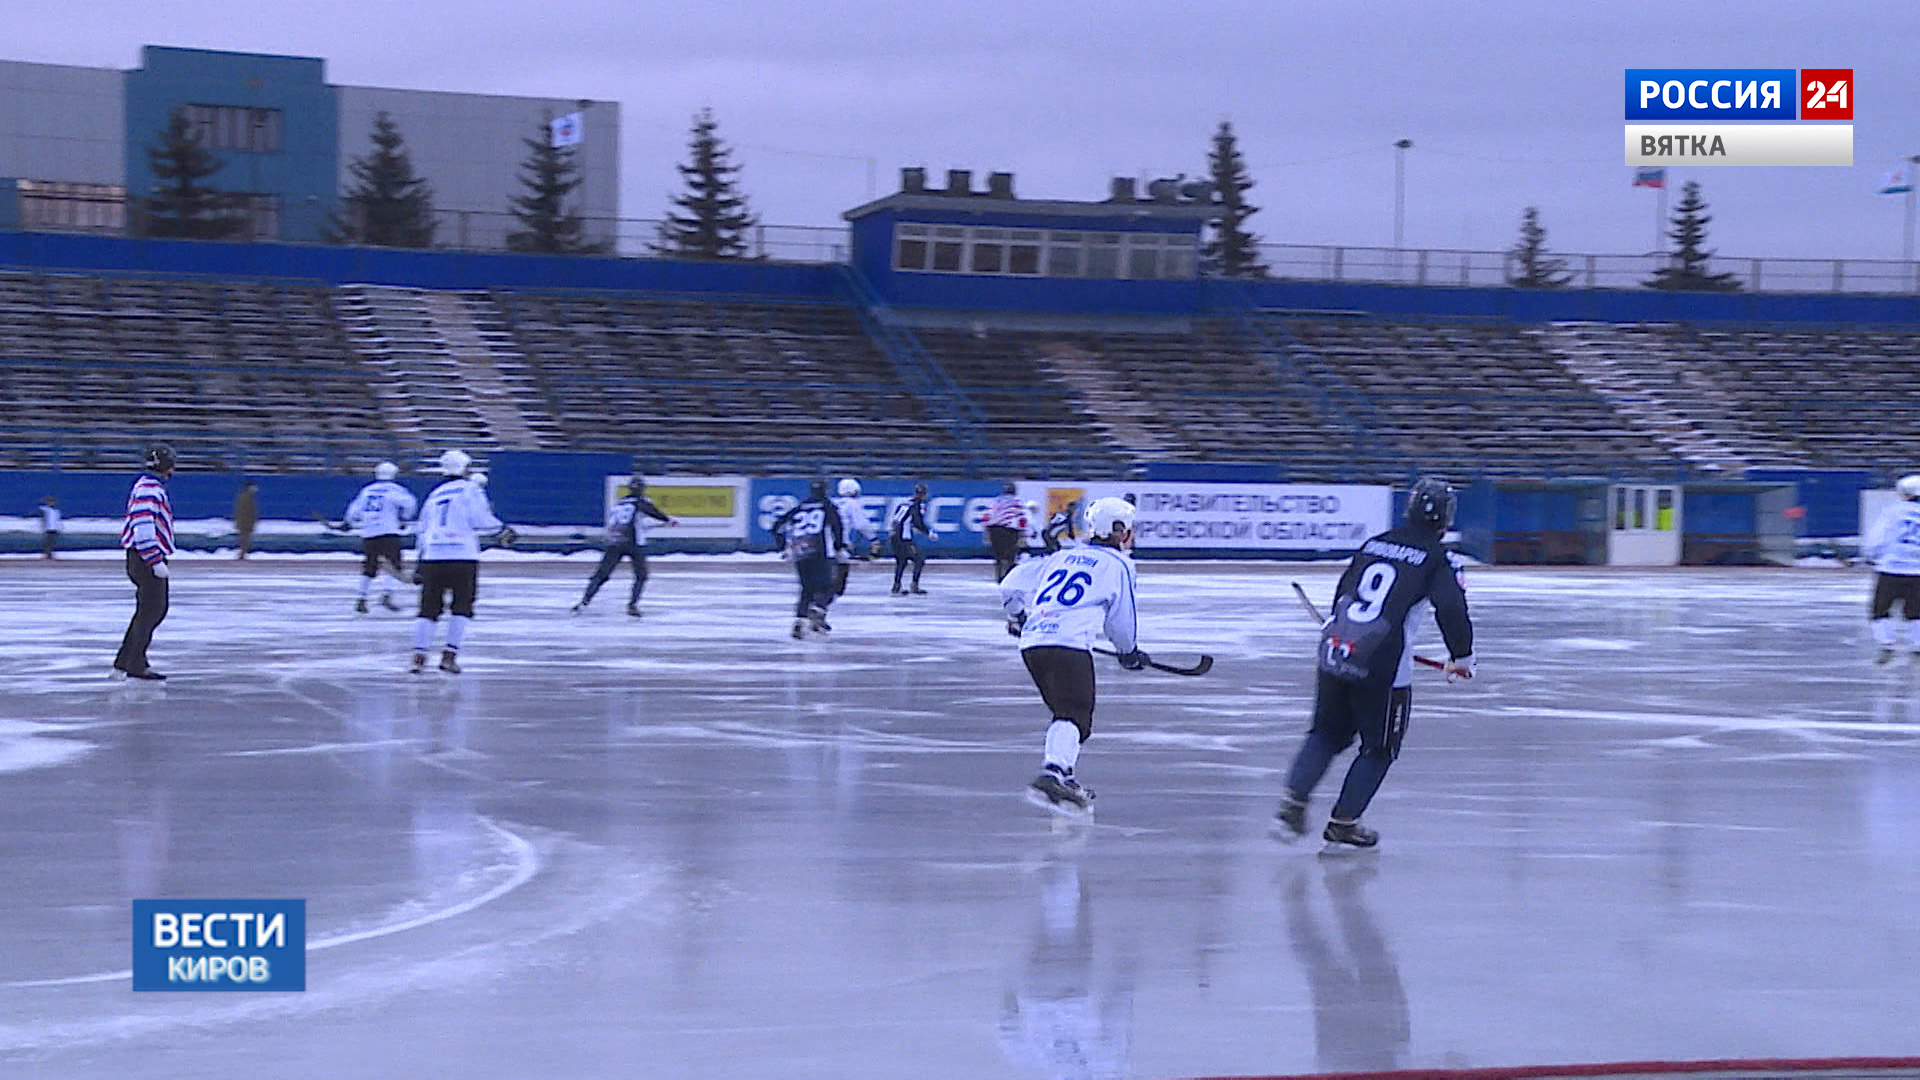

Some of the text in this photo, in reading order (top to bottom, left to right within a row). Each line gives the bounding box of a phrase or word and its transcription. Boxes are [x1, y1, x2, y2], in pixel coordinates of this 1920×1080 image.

[1140, 493, 1341, 513] ПРАВИТЕЛЬСТВО
[792, 509, 825, 537] 29
[1132, 517, 1367, 541] РОВСКОЙ ОБЛАСТИ
[1036, 568, 1092, 606] 26
[1346, 562, 1397, 623] 9
